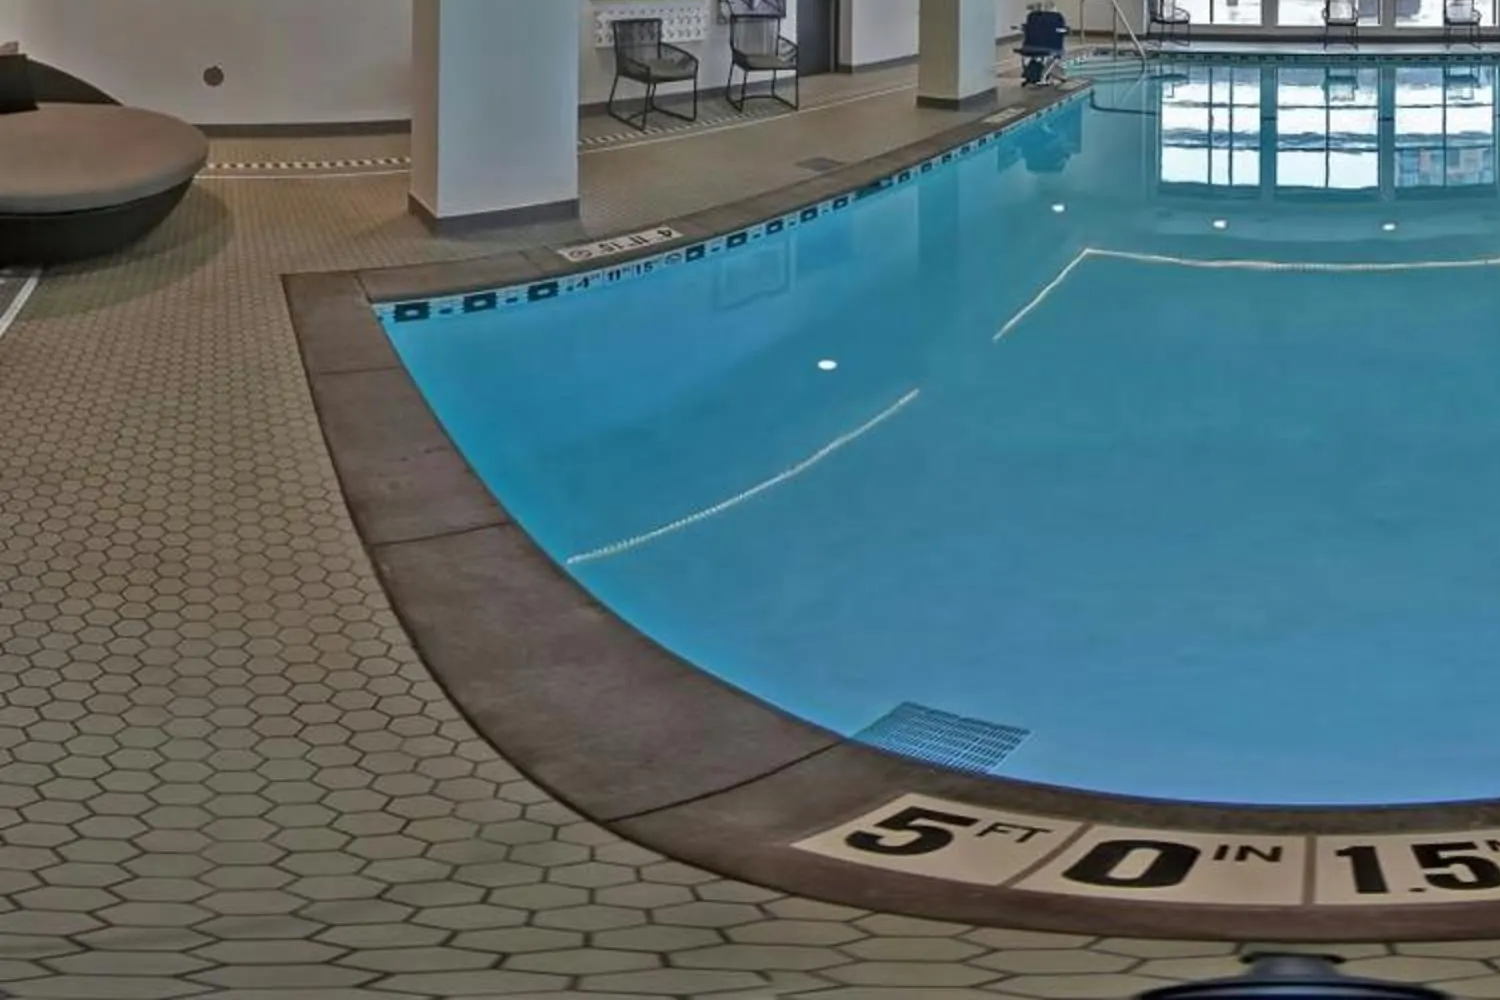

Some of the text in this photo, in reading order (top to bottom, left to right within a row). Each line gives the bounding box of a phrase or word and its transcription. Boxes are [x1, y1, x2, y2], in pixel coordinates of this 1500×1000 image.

[845, 806, 979, 856] 5
[975, 822, 1051, 844] FT
[1061, 839, 1202, 888] 0
[1213, 844, 1284, 862] IN
